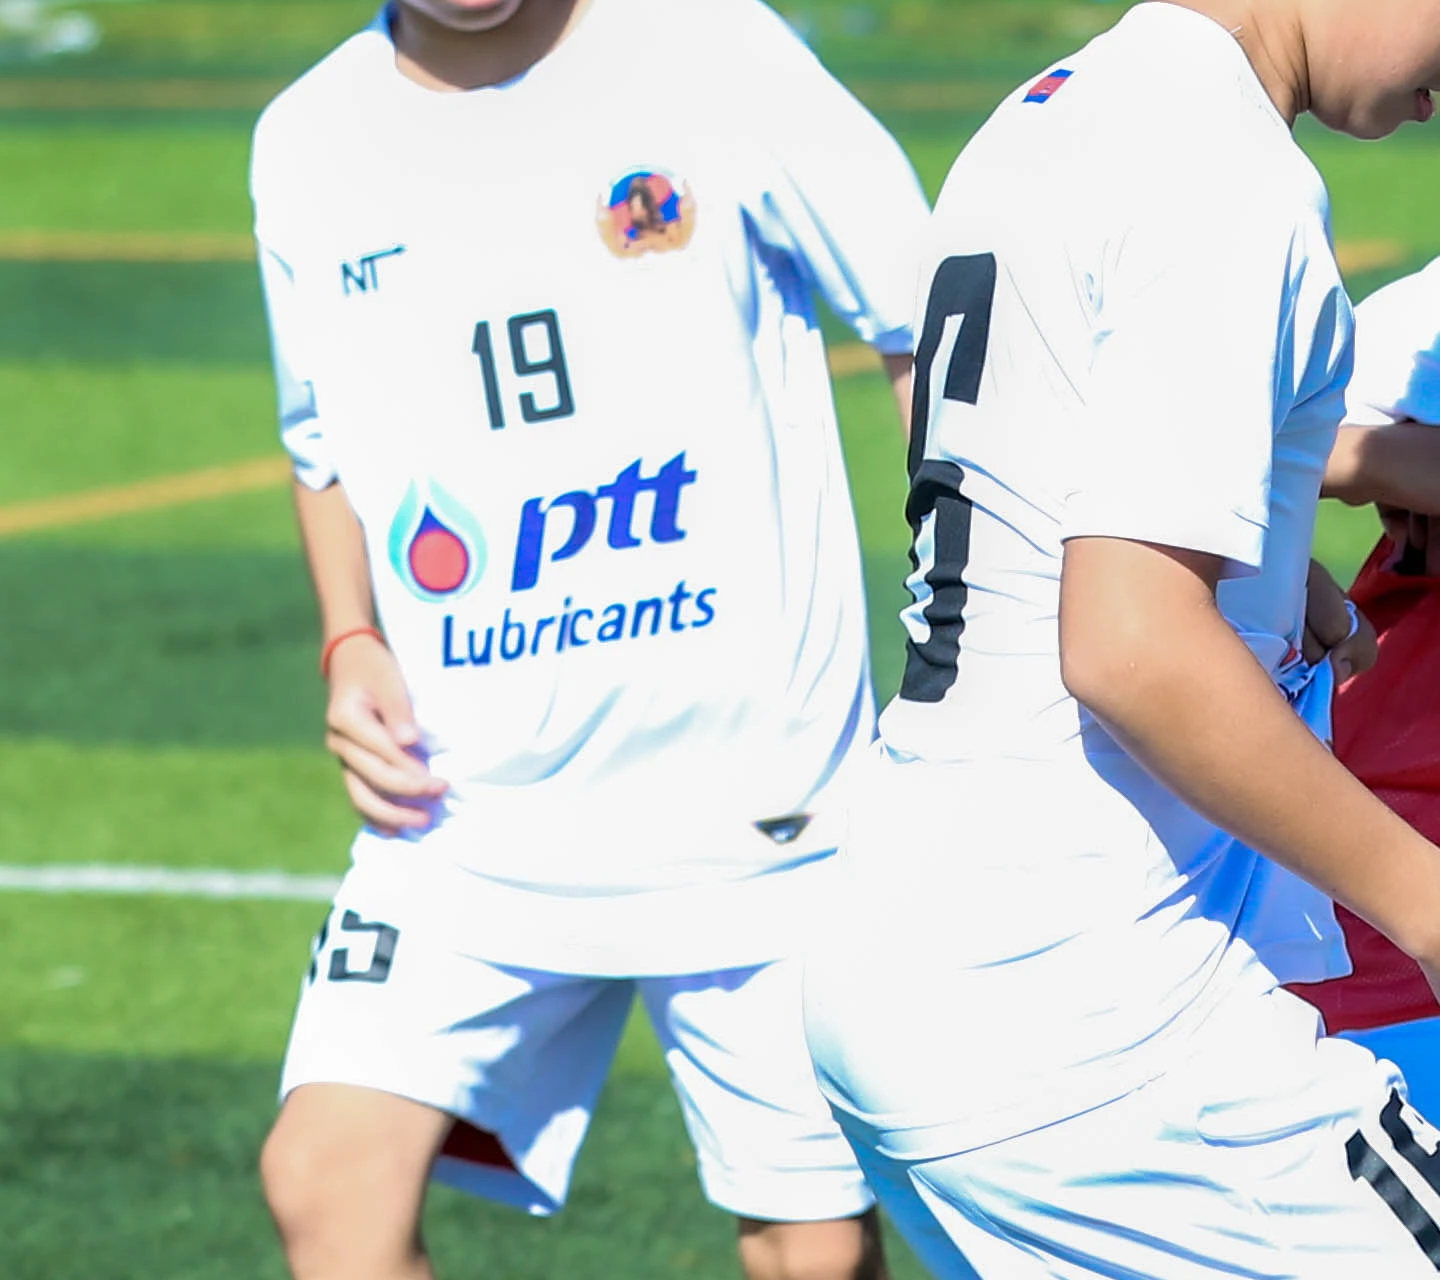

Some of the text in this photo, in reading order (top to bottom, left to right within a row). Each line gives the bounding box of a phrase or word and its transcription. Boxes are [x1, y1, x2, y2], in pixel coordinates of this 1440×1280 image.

[342, 244, 407, 297] NT
[472, 308, 576, 430] 19
[511, 450, 698, 592] ptt
[442, 581, 718, 669] Lubricants
